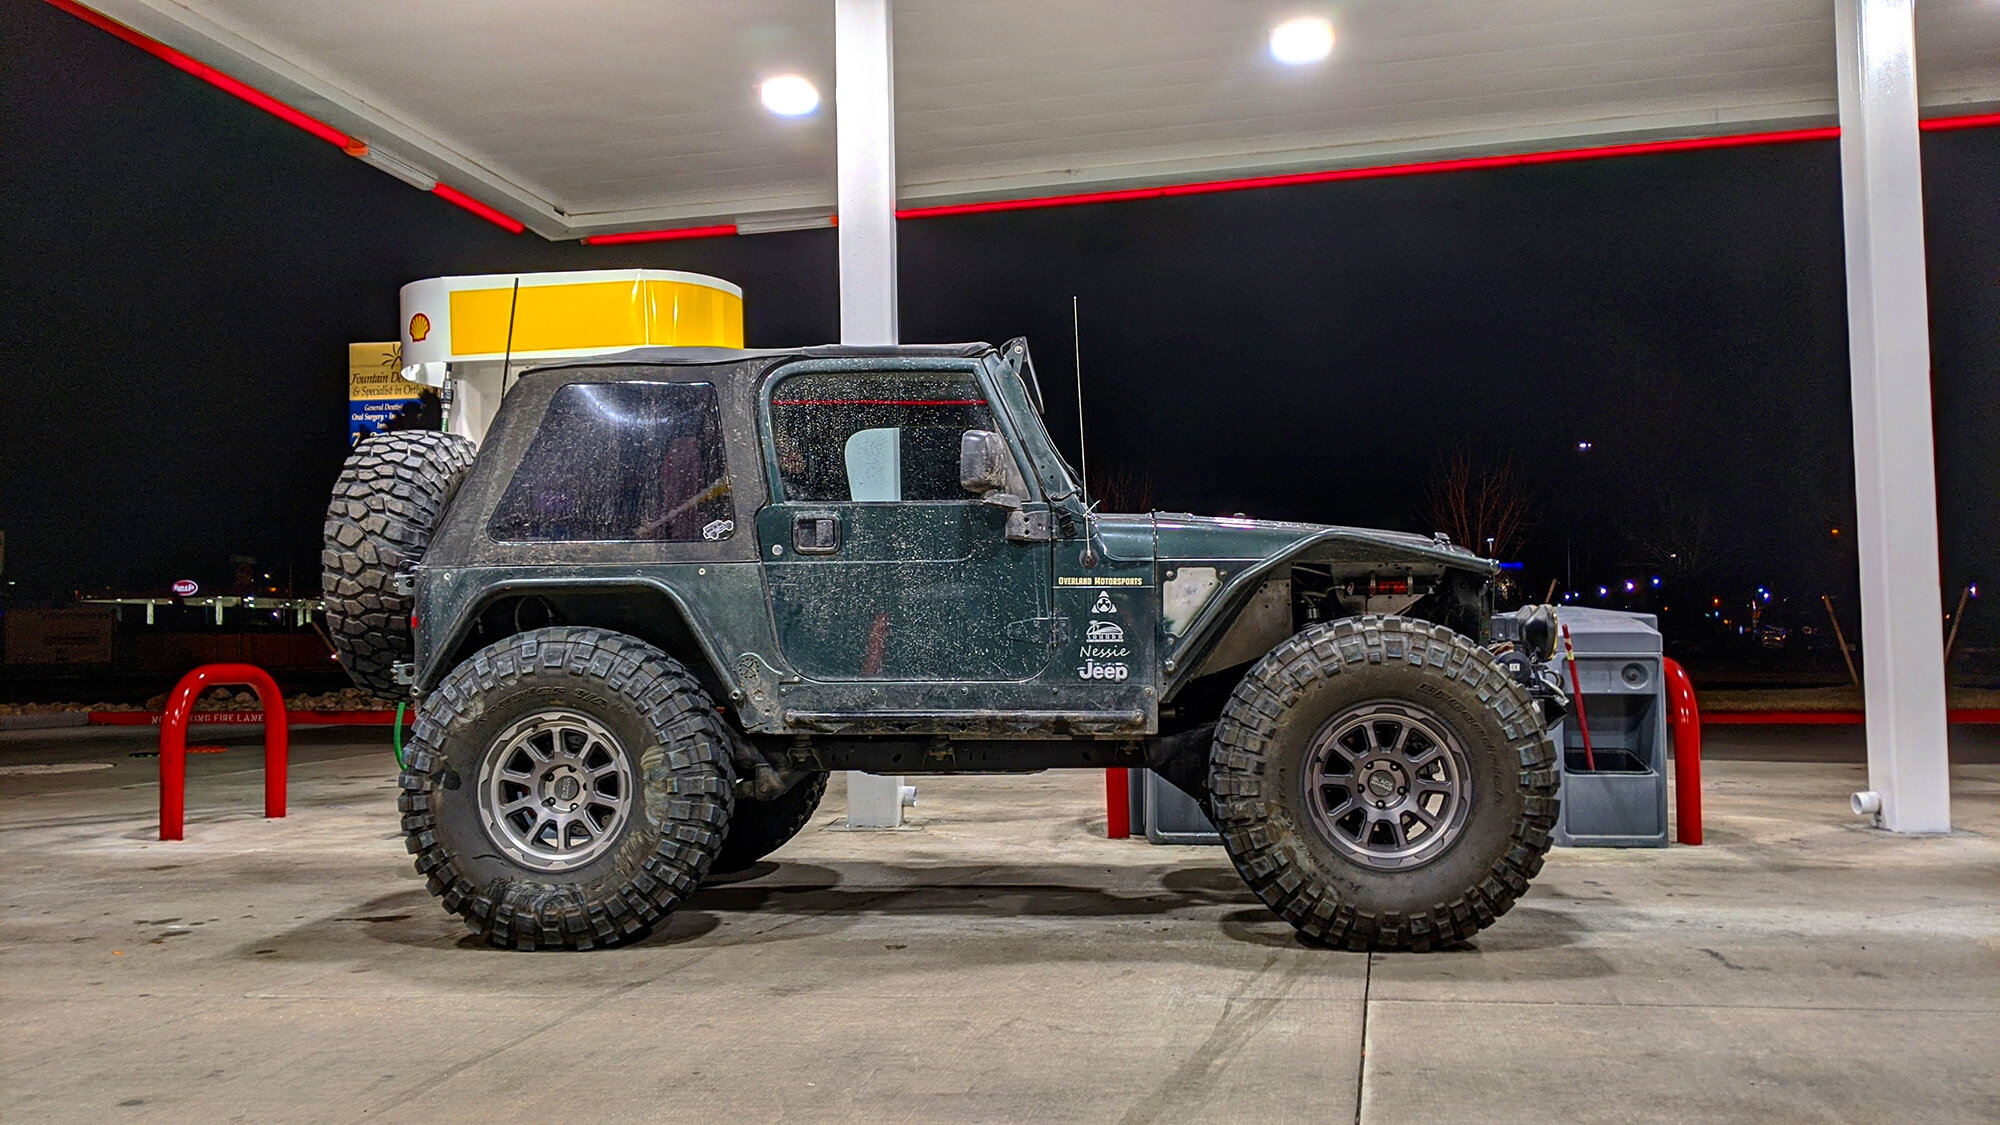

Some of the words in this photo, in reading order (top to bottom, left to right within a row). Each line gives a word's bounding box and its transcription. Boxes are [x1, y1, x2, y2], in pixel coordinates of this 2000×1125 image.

[351, 372, 388, 385] Fountain
[352, 386, 360, 397] &
[361, 385, 393, 397] Specialist
[395, 385, 402, 395] in
[365, 413, 384, 422] Surgery
[1079, 644, 1131, 658] Nessie
[1078, 659, 1128, 682] Jeep
[213, 713, 234, 722] FIRE
[236, 713, 264, 722] LANE
